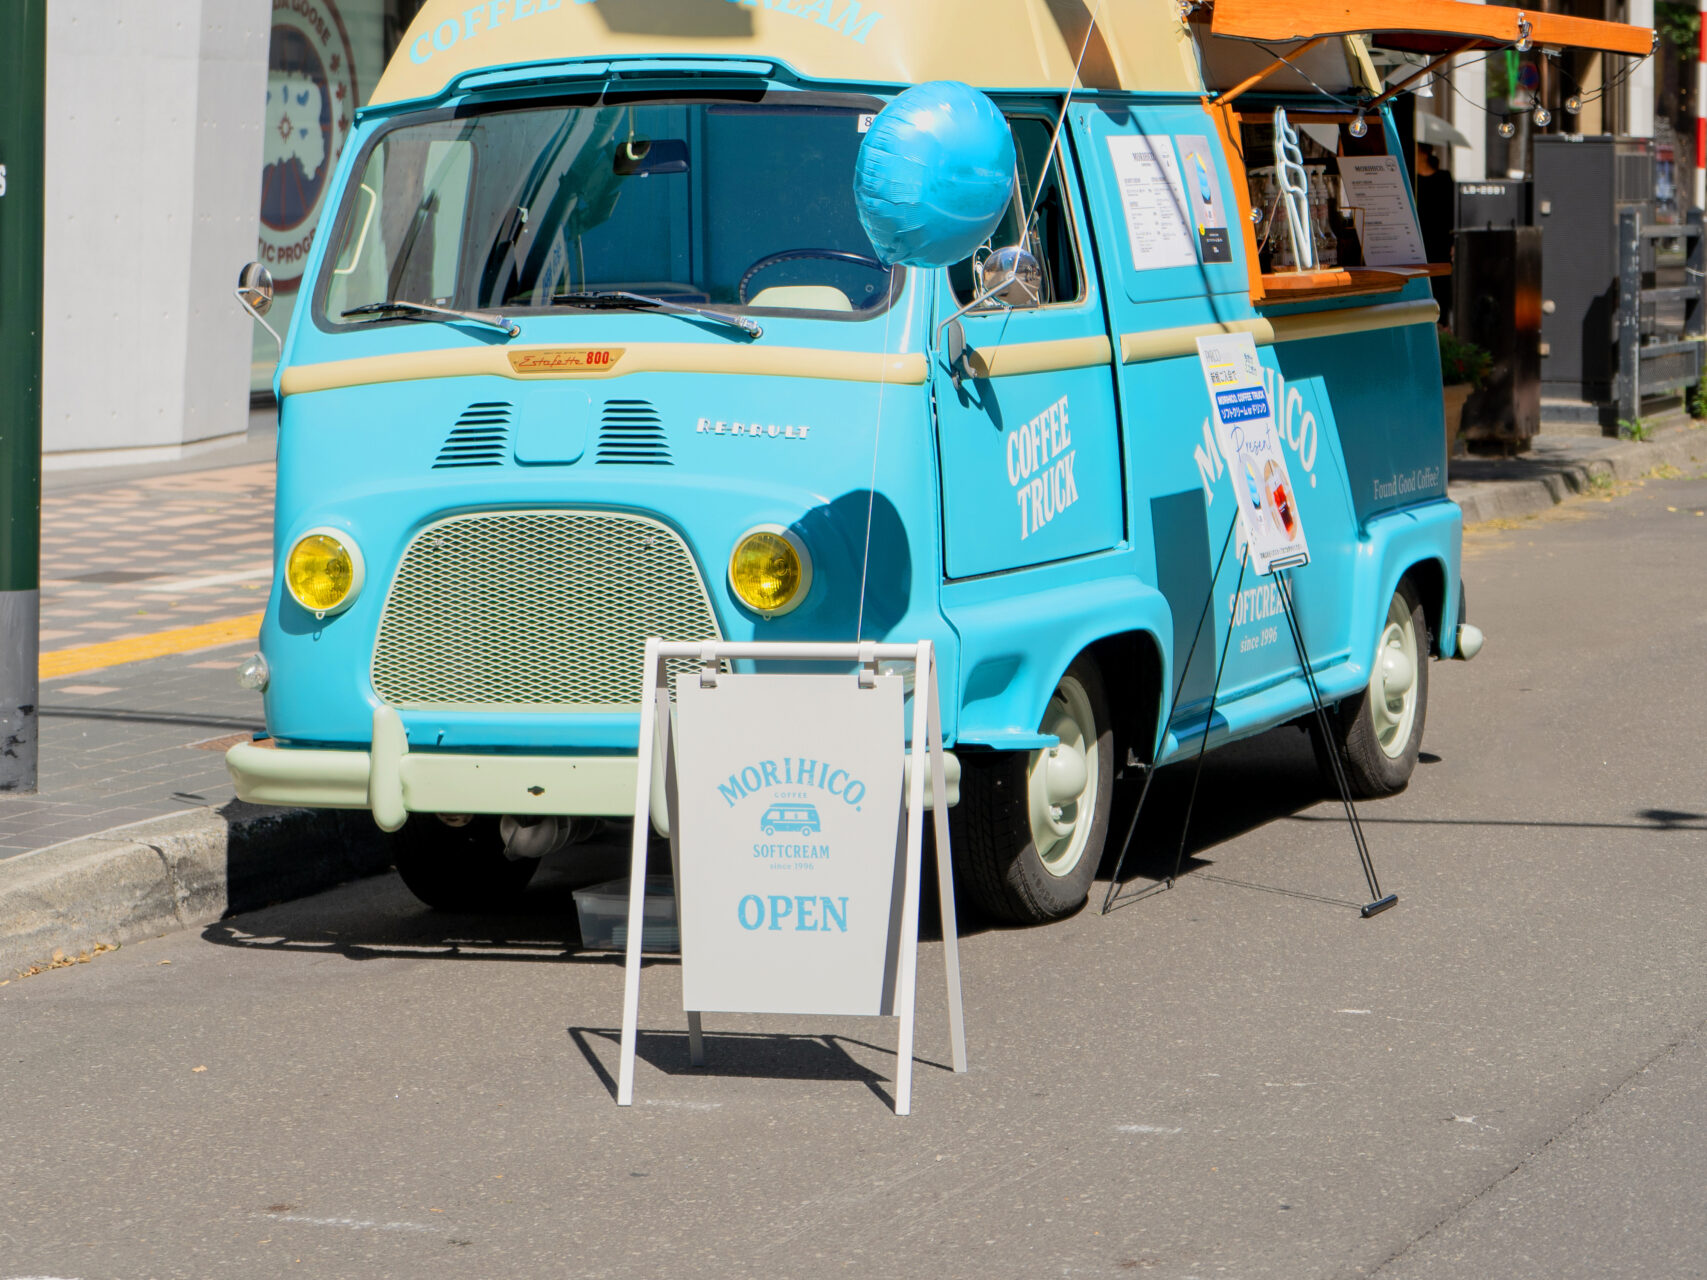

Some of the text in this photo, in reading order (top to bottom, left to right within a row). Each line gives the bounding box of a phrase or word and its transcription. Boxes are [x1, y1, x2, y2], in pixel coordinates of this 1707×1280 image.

[518, 351, 610, 368] Estafette 800
[696, 417, 810, 439] RENAULT
[1007, 393, 1072, 487] COFFEE
[1230, 422, 1273, 463] Present
[1017, 449, 1079, 541] TRUCK
[1374, 474, 1398, 500] Found
[1398, 470, 1416, 494] Good
[1240, 626, 1278, 654] since 1996
[717, 757, 867, 813] MORIHICO.
[774, 791, 809, 799] COFFEE
[752, 843, 831, 860] SOFTCREAM
[769, 862, 815, 871] since 1996
[737, 893, 850, 933] OPEN
